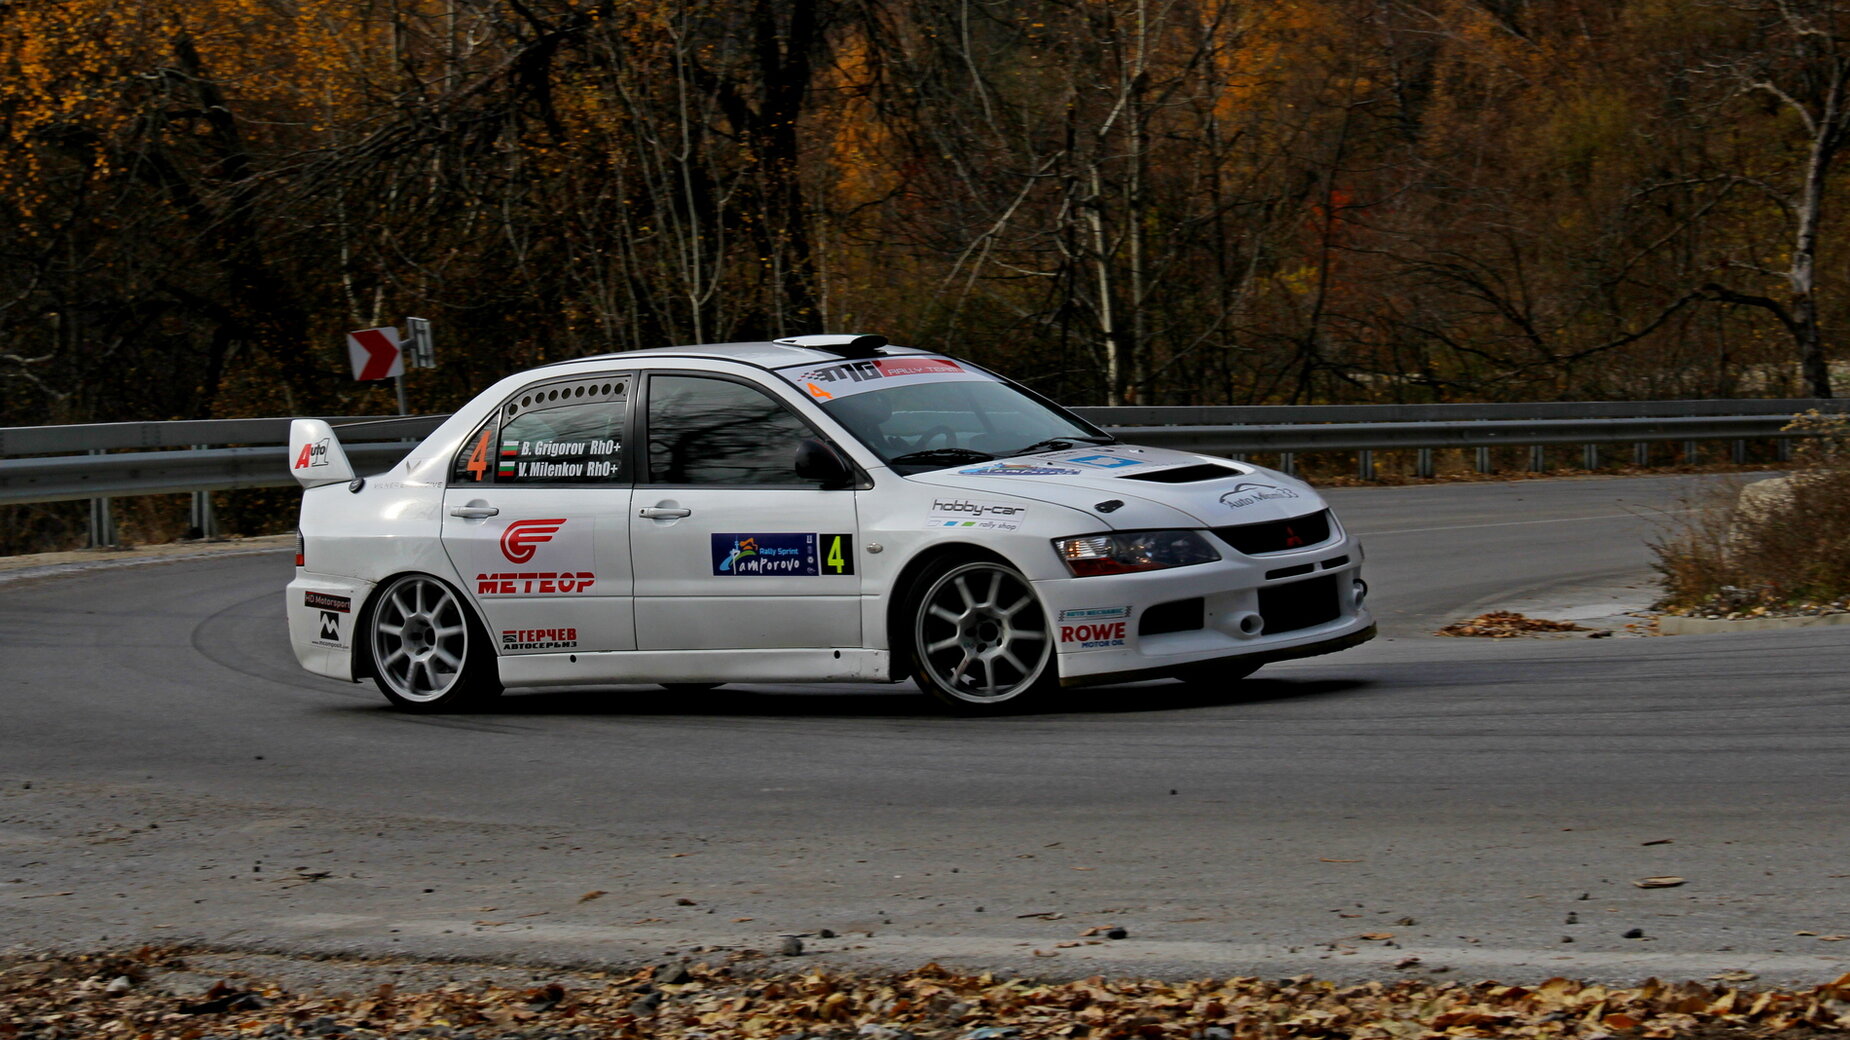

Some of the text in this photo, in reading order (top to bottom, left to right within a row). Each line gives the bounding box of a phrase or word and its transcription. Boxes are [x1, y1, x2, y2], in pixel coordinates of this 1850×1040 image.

[887, 367, 922, 375] RALLY
[806, 382, 834, 400] 4
[466, 430, 492, 481] 4
[521, 441, 532, 456] B.
[534, 440, 586, 457] Grigorov
[518, 462, 528, 477] V.
[529, 461, 583, 477] Milenkov
[932, 499, 1025, 516] hobby-car
[979, 521, 1017, 531] rally shop
[759, 547, 799, 556] Rally Sprint
[827, 535, 845, 574] 4
[730, 548, 800, 575] Pamporovo
[476, 572, 595, 594] МЕТЕОР
[315, 596, 351, 609] Motorsport
[518, 628, 577, 642] ГЕРЧЕВ
[1060, 622, 1126, 643] ROWE
[1081, 641, 1109, 649] MOTOR
